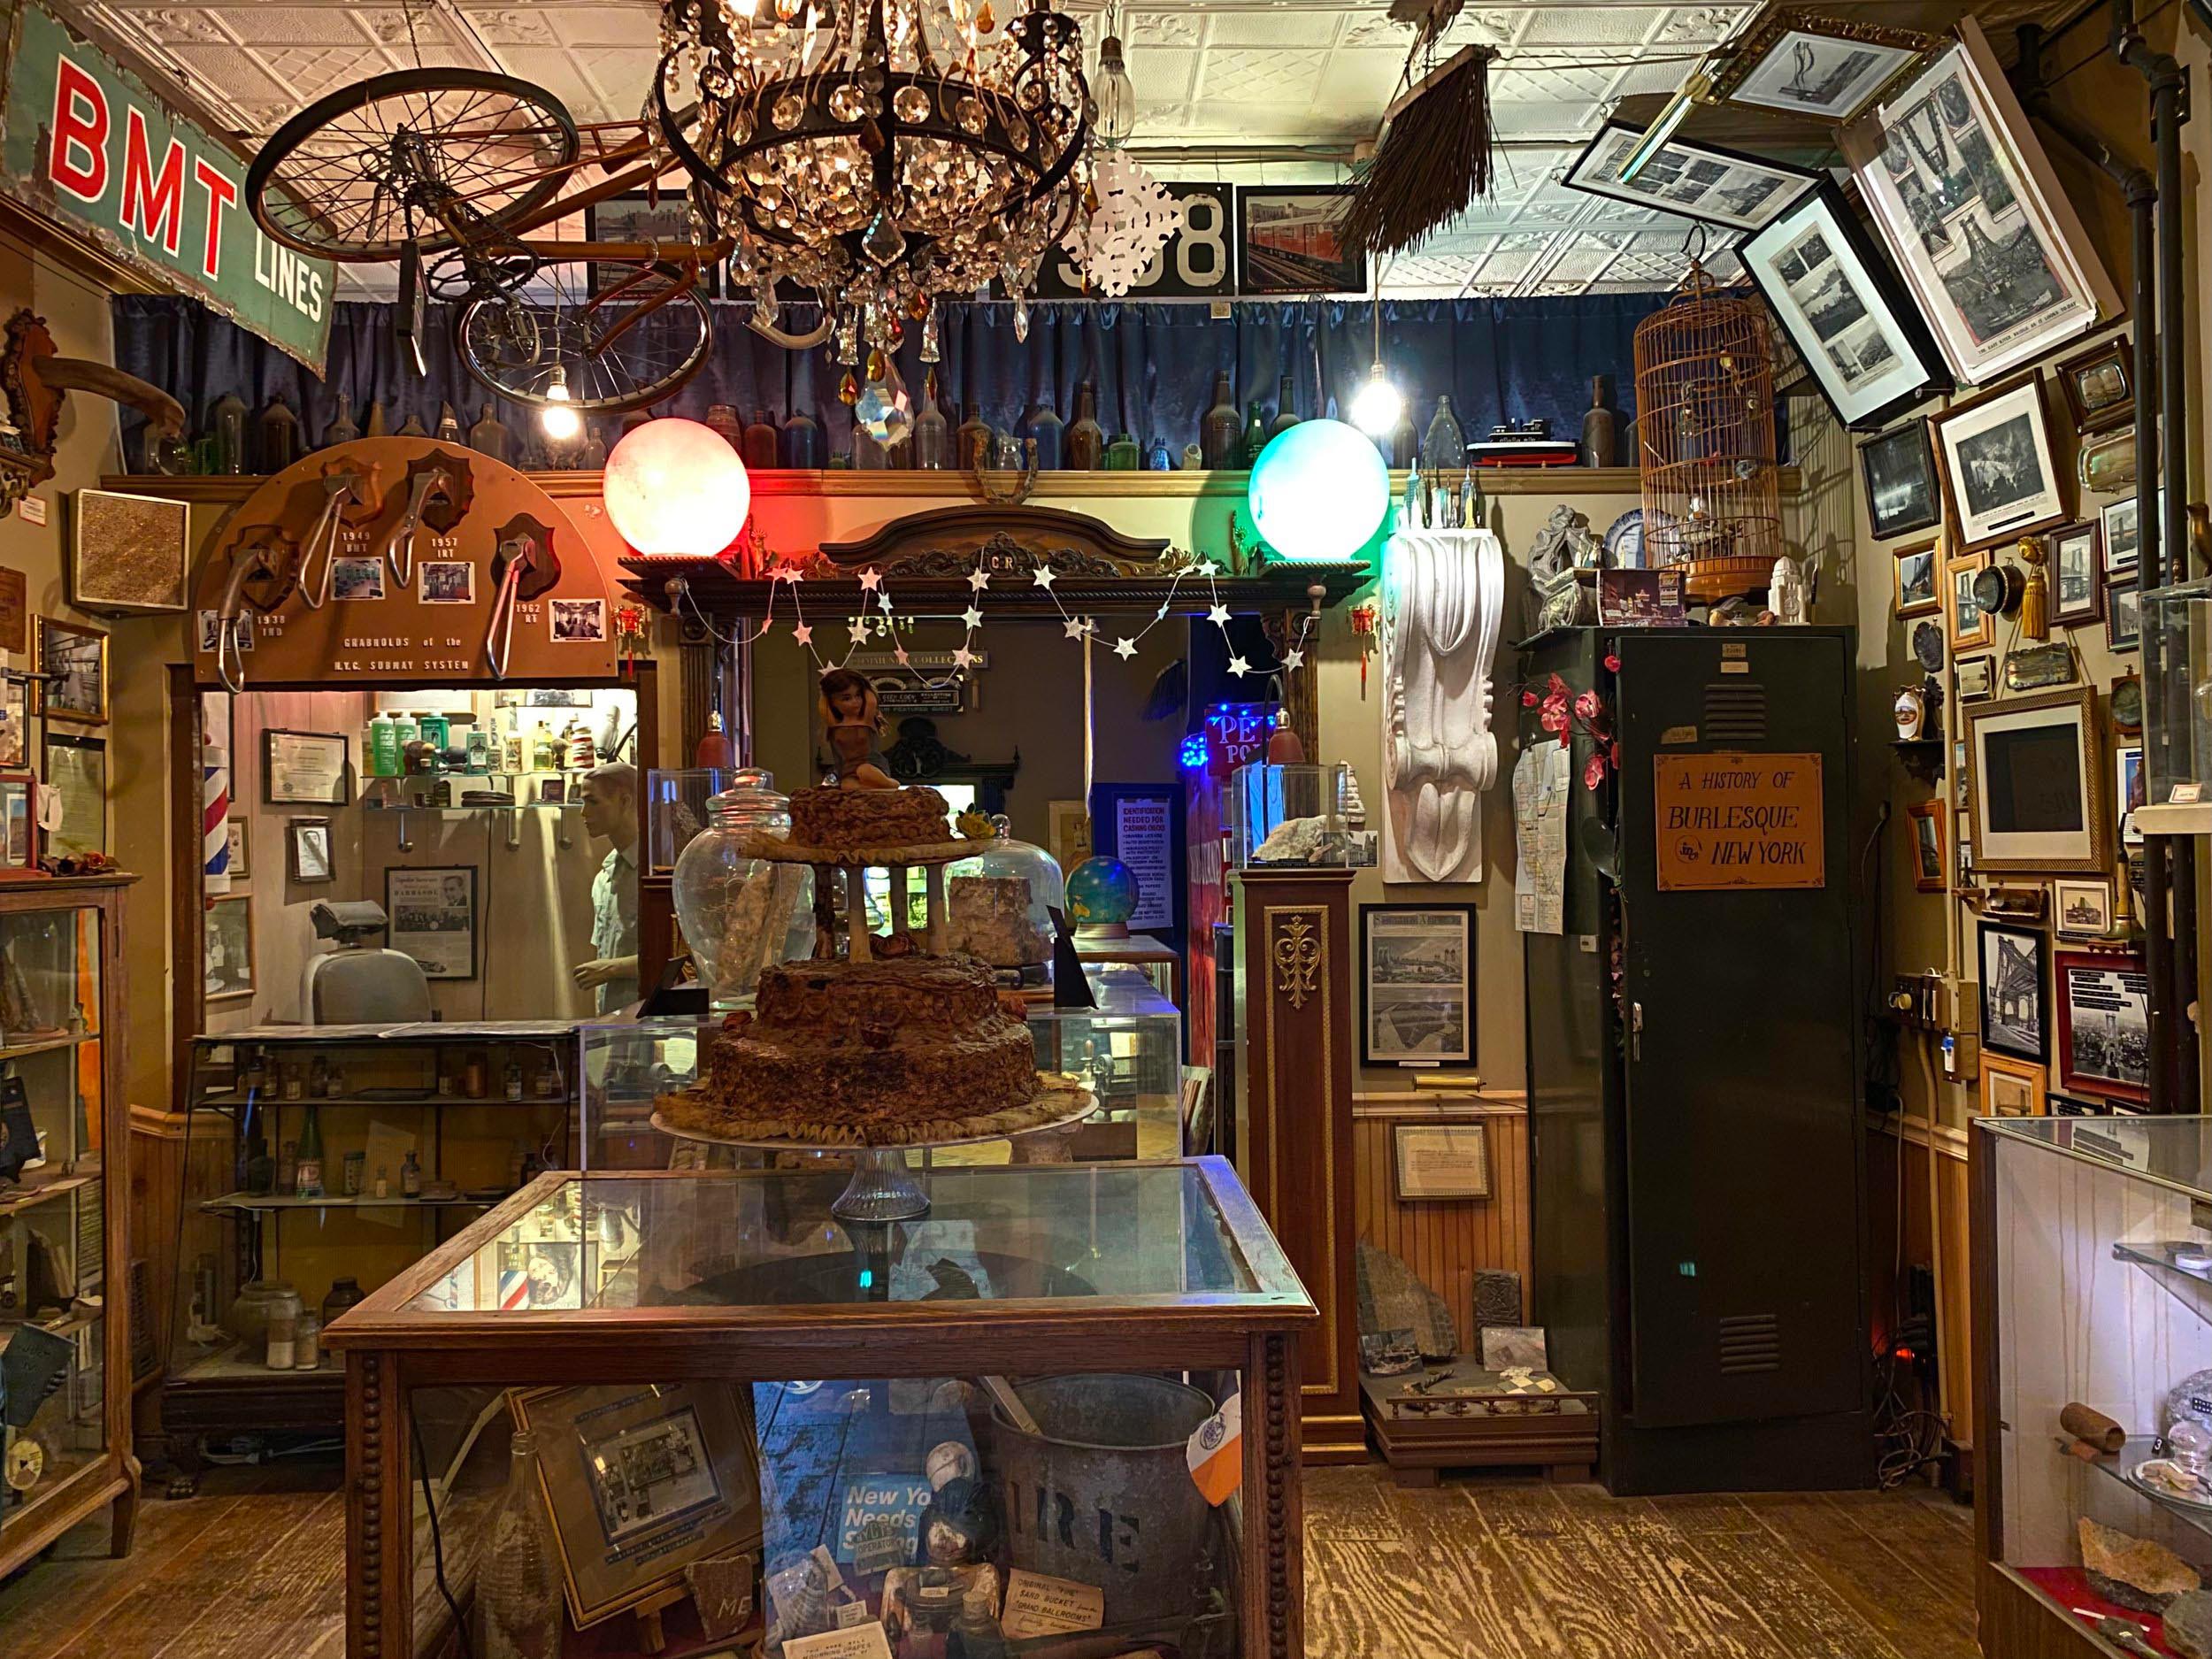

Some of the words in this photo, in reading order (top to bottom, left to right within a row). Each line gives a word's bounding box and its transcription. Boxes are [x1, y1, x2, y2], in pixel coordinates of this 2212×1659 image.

[50, 53, 237, 280] BMT
[254, 227, 323, 322] LINES
[342, 532, 371, 541] 1949
[432, 538, 457, 548] 1957
[346, 544, 367, 553] BMT
[437, 549, 454, 558] IRT
[991, 556, 1000, 569] C
[1004, 556, 1014, 570] R
[516, 604, 541, 613] 1962
[257, 616, 285, 625] 1938
[262, 628, 282, 637] IND
[343, 638, 409, 648] GRABHOLDS
[423, 638, 434, 647] of
[446, 638, 461, 647] the
[370, 661, 413, 671] SUBWAY
[424, 661, 469, 670] SYSTEM
[1678, 772, 1692, 789] A
[1701, 772, 1762, 789] HISTORY
[1772, 772, 1796, 788] OF
[1665, 806, 1800, 835] BURLESQUE
[1711, 841, 1755, 864] NEW
[1757, 841, 1807, 864] YORK
[2154, 1440, 2162, 1449] 3
[847, 1486, 899, 1506] New
[906, 1486, 932, 1506] Yo
[844, 1508, 917, 1529] Needs
[1010, 1481, 1141, 1574] IRE
[1018, 1578, 1049, 1592] ORIGINAL
[1019, 1590, 1041, 1600] SAND
[1044, 1595, 1075, 1608] BUCKET
[718, 1597, 751, 1618] ME
[1041, 1606, 1091, 1623] BALLROOMS"
